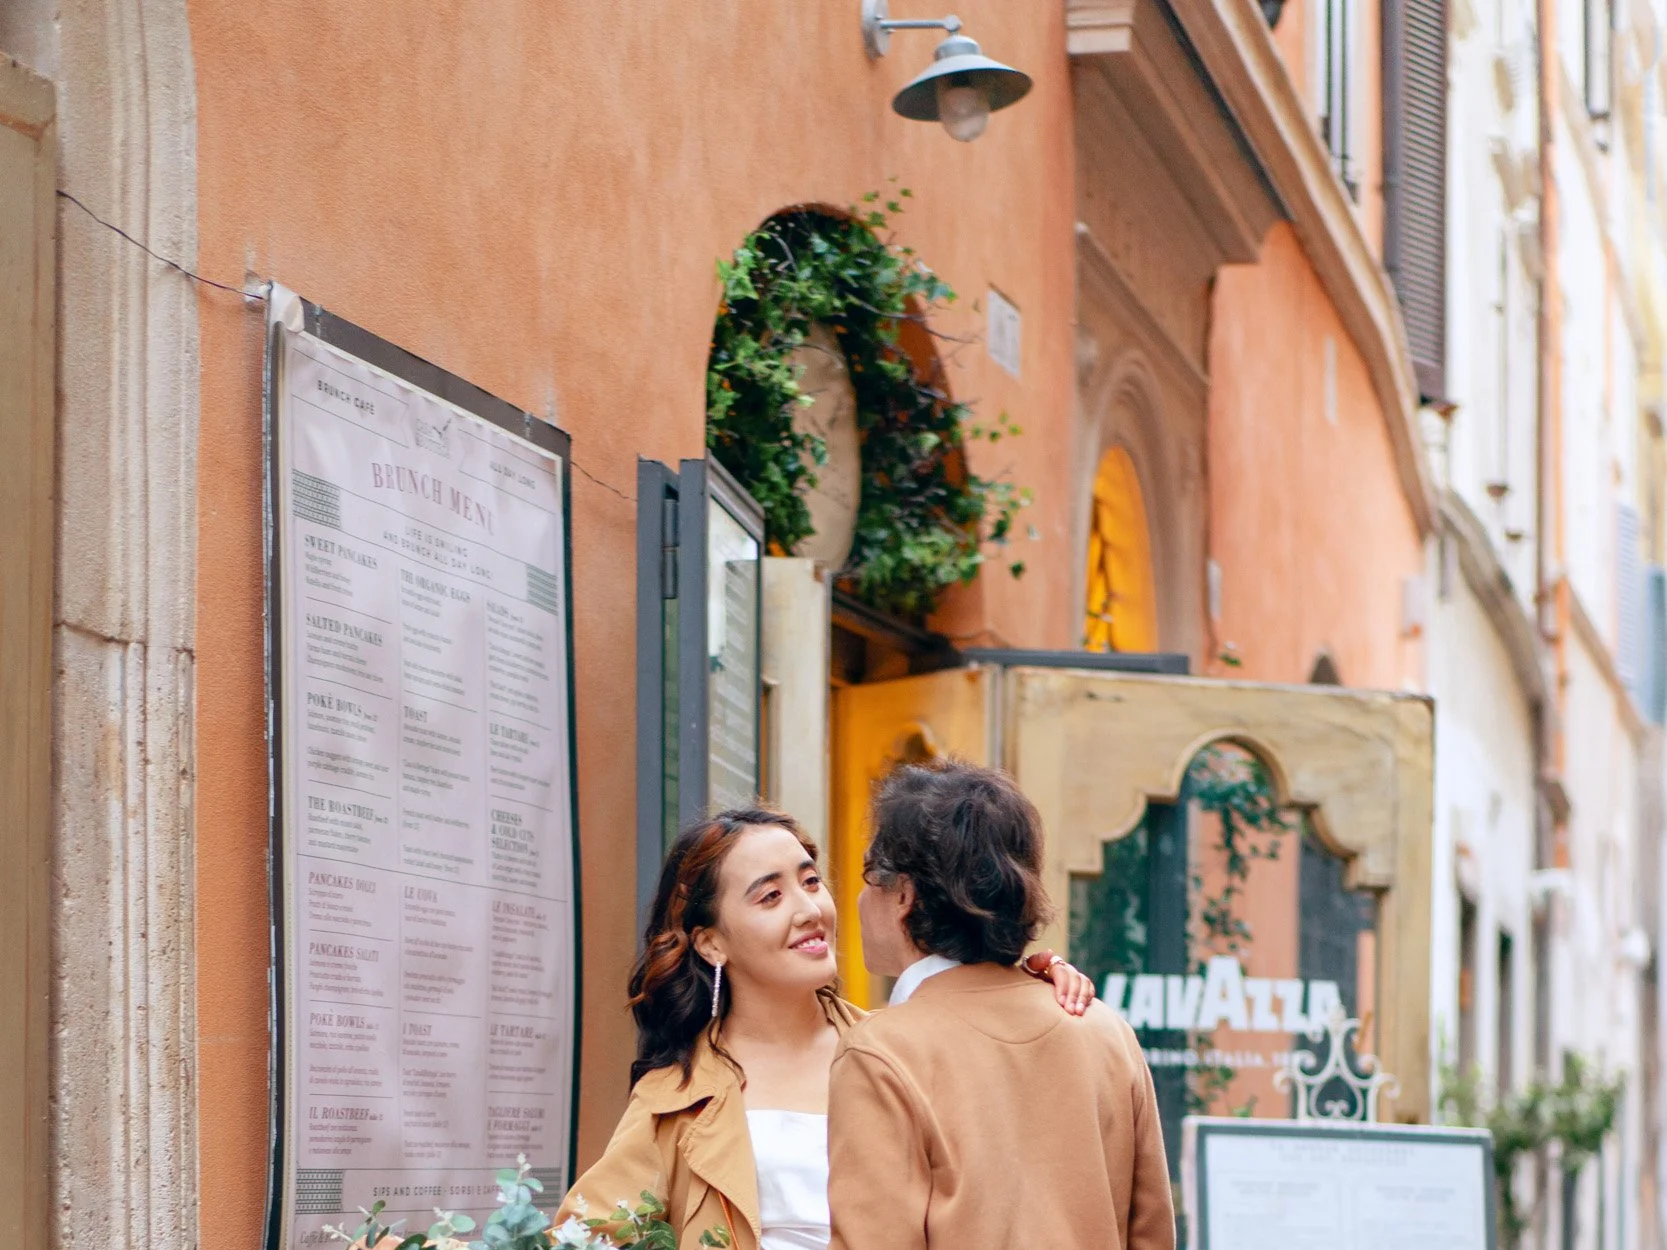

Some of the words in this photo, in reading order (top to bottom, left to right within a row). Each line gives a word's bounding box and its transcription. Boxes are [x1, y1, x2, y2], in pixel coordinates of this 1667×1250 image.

[318, 380, 351, 403] BRUNCH
[371, 462, 442, 505] BRUNCH
[449, 487, 494, 535] MENU
[305, 535, 334, 554] SWEET
[383, 531, 398, 544] AND
[402, 540, 432, 558] BRUNCH
[401, 569, 413, 584] THE
[306, 613, 340, 633] SALTED
[343, 623, 383, 647] PANCAKES
[308, 796, 326, 811] THE
[309, 872, 353, 889] PANCAKES
[404, 885, 414, 899] LE
[309, 942, 353, 958] PANCAKES
[1103, 956, 1344, 1034] LAVAZZA
[337, 1014, 365, 1028] BOWLS
[309, 1106, 318, 1119] IL
[322, 1107, 370, 1120] ROASTBEEF
[373, 1187, 390, 1196] SIPS
[393, 1187, 410, 1196] AND
[414, 1186, 441, 1196] COFFEE
[450, 1186, 474, 1195] SORSI
[484, 1186, 503, 1195] CAFF
